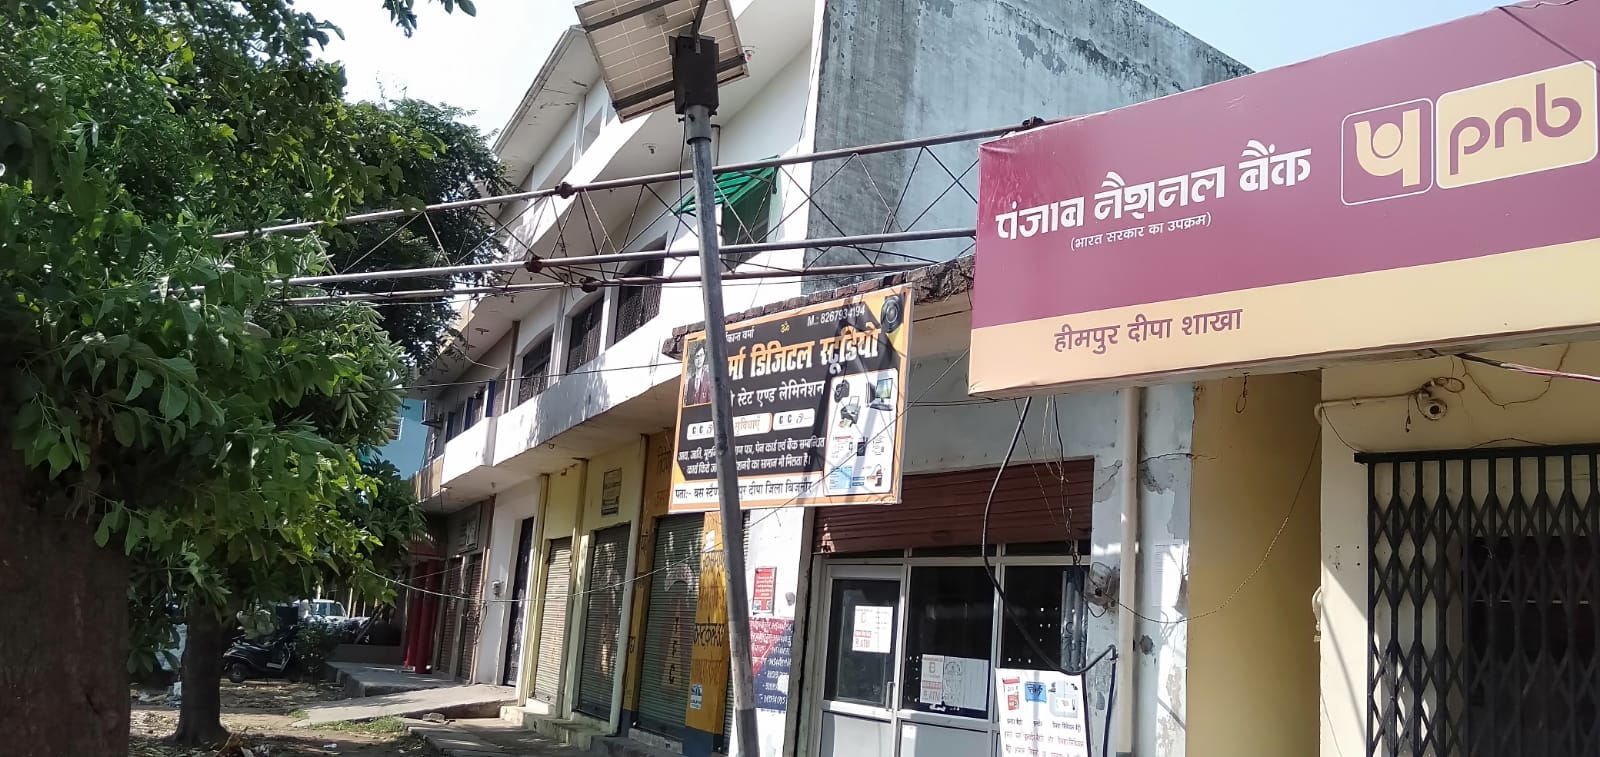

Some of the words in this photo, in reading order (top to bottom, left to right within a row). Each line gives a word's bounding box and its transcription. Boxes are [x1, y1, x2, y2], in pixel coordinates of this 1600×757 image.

[1449, 83, 1582, 175] pnb
[995, 196, 1085, 241] पंजाब
[1094, 171, 1226, 221] नैशनल
[1238, 139, 1312, 193] बैंक
[1070, 231, 1103, 252] (भारत
[1106, 225, 1145, 246] सरकार
[1148, 221, 1165, 237] का
[1166, 211, 1212, 234] उपक्रम)
[1053, 322, 1121, 354] हीमपुर
[1127, 312, 1173, 345] दीपा
[1180, 308, 1243, 336] शाखा
[750, 340, 817, 378] डिजिटल
[737, 386, 753, 406] स्टेट
[778, 377, 827, 401] लेमिनेशन
[693, 487, 704, 498] बस
